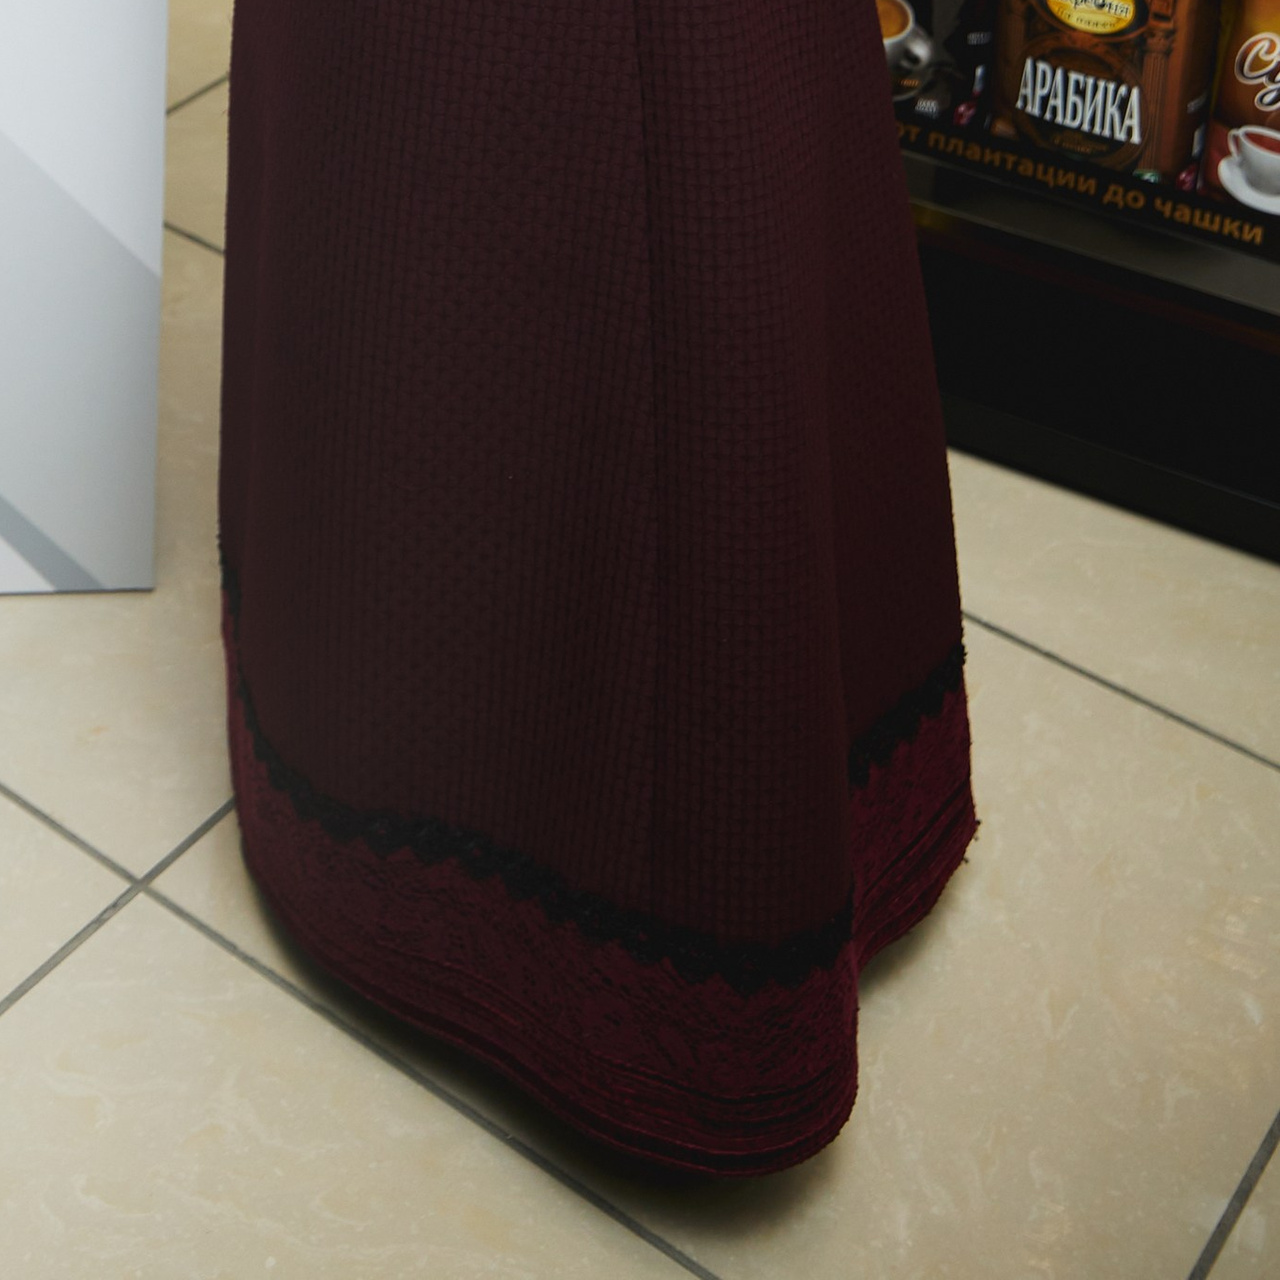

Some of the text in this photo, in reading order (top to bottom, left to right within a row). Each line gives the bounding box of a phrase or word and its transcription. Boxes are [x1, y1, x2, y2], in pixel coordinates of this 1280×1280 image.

[1016, 56, 1141, 145] АРАБИКА
[928, 130, 1097, 196] плантации
[1103, 183, 1147, 210] до
[1153, 197, 1265, 246] чашки
